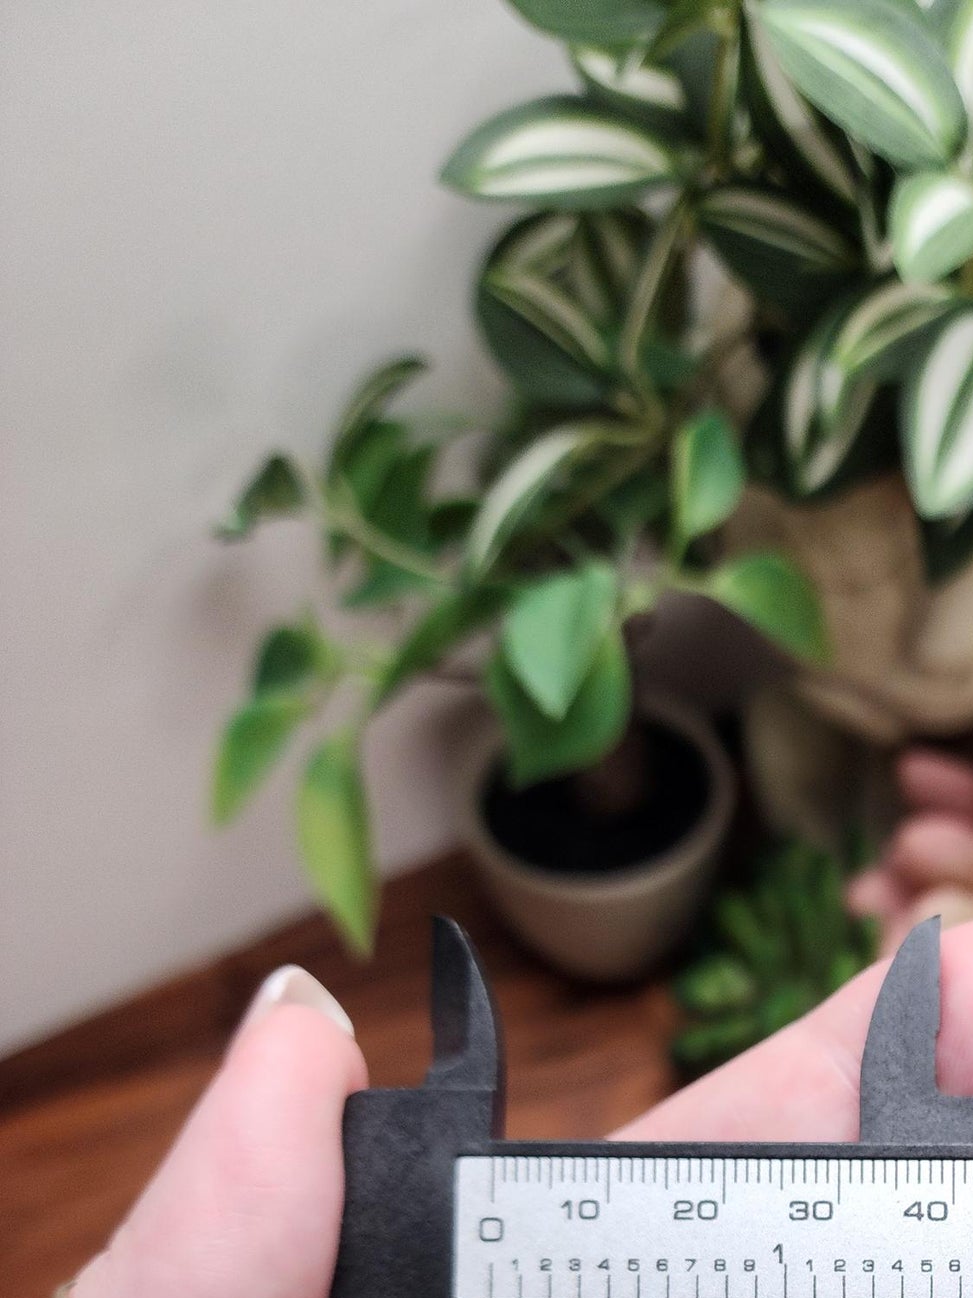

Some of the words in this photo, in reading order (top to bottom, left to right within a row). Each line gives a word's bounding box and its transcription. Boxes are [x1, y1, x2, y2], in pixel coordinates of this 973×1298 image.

[478, 1216, 504, 1242] 0
[560, 1199, 600, 1221] 10
[673, 1199, 718, 1221] 20
[788, 1200, 834, 1221] 30
[903, 1200, 948, 1222] 40
[512, 1258, 519, 1271] 1
[539, 1258, 552, 1272] 2
[568, 1258, 581, 1272] 3
[597, 1258, 610, 1271] 4
[627, 1258, 640, 1272] 5
[655, 1258, 668, 1272] 6
[684, 1258, 697, 1272] 7
[713, 1258, 727, 1272] 8
[743, 1259, 756, 1273] 9
[772, 1243, 784, 1264] 1
[805, 1259, 813, 1272] 1
[833, 1258, 847, 1273] 2
[862, 1259, 875, 1273] 3
[891, 1259, 904, 1272] 4
[920, 1259, 933, 1273] 5
